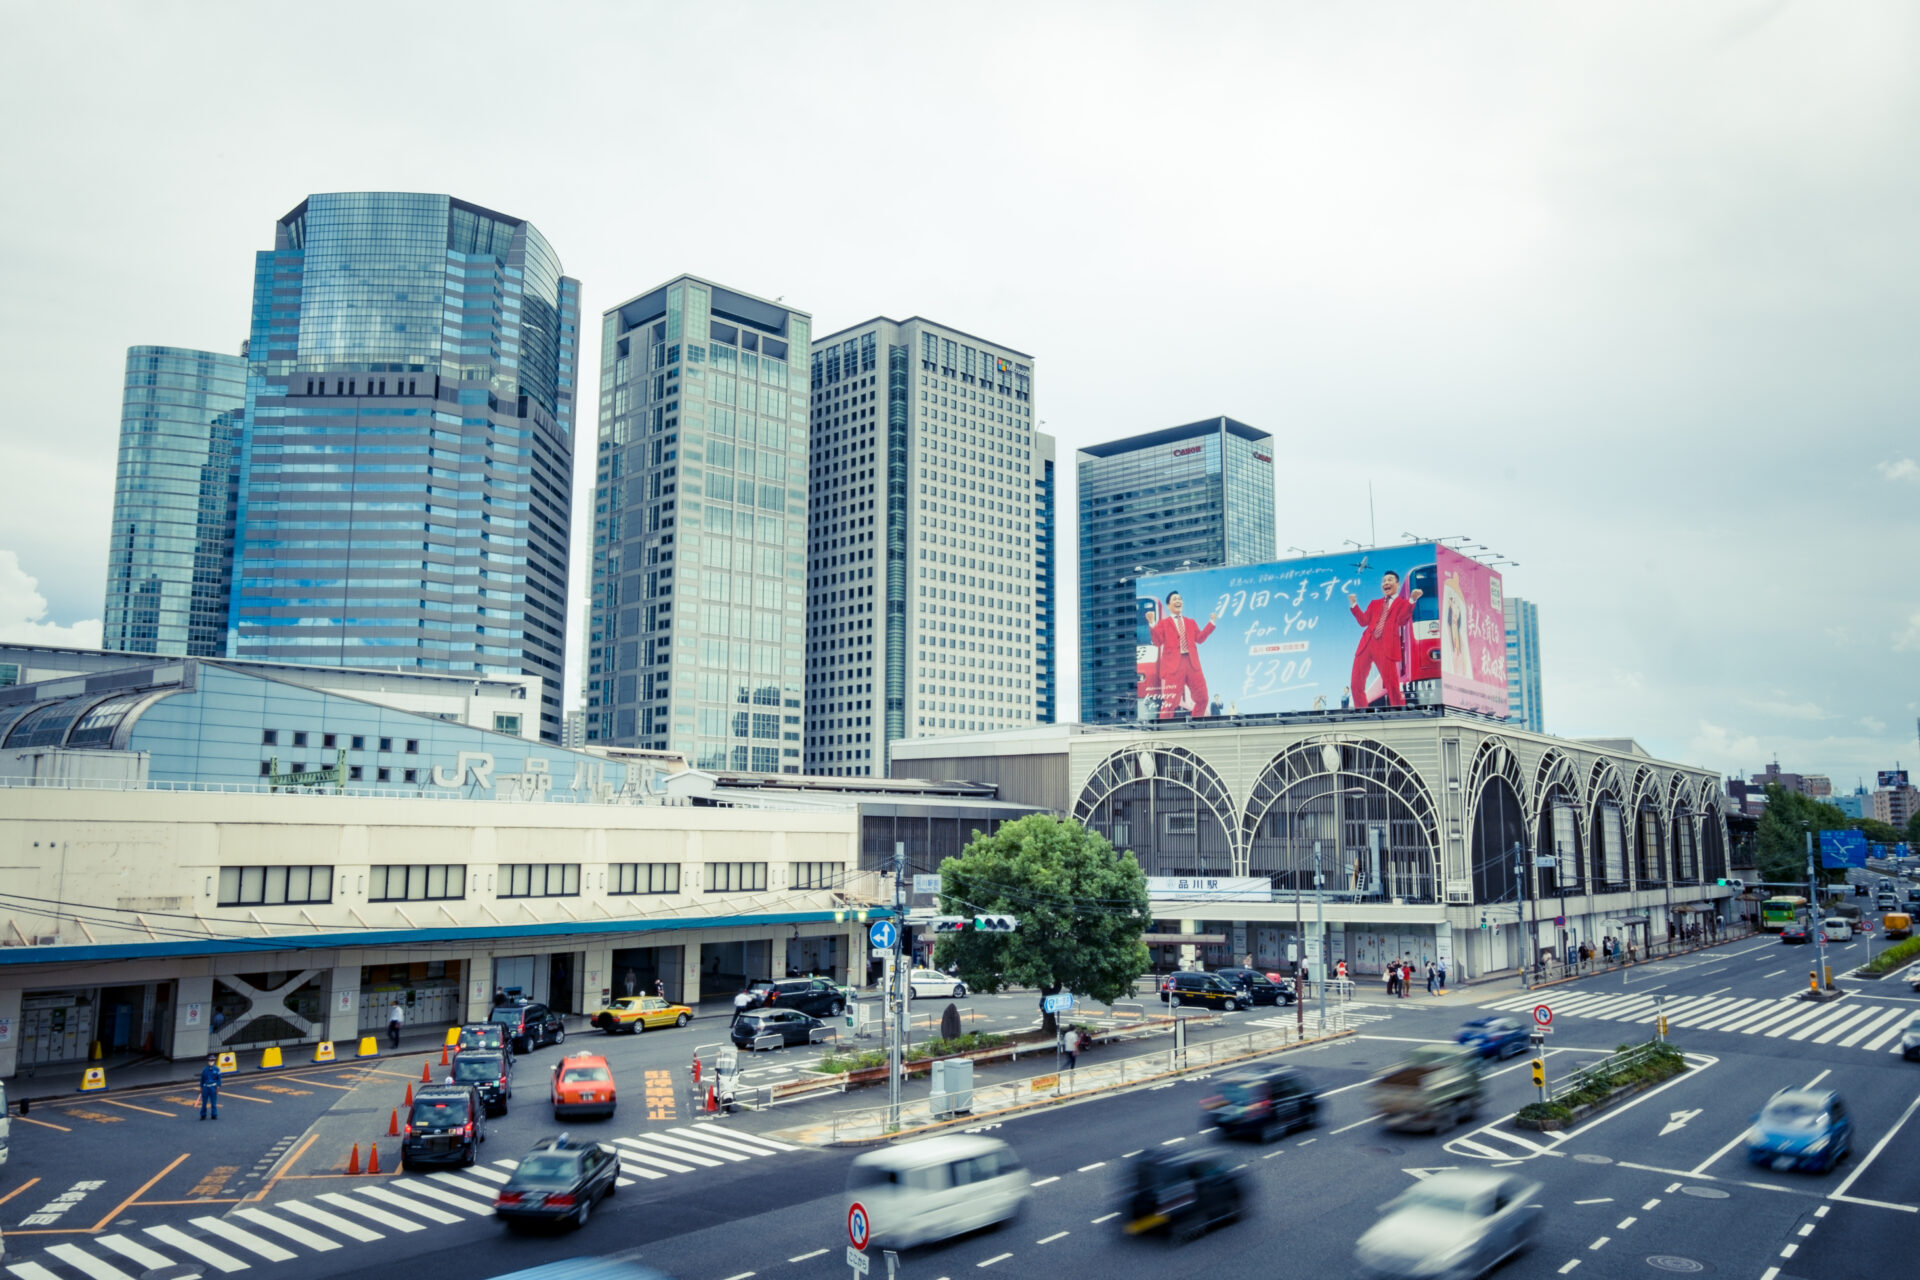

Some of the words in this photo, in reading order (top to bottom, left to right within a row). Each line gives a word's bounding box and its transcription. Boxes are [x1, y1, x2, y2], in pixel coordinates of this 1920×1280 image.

[1215, 577, 1361, 618] 羽田へまっすぐ
[1244, 620, 1277, 644] for
[1241, 657, 1312, 696] ¥300
[432, 751, 495, 788] JR
[1178, 879, 1218, 890] 品川駅
